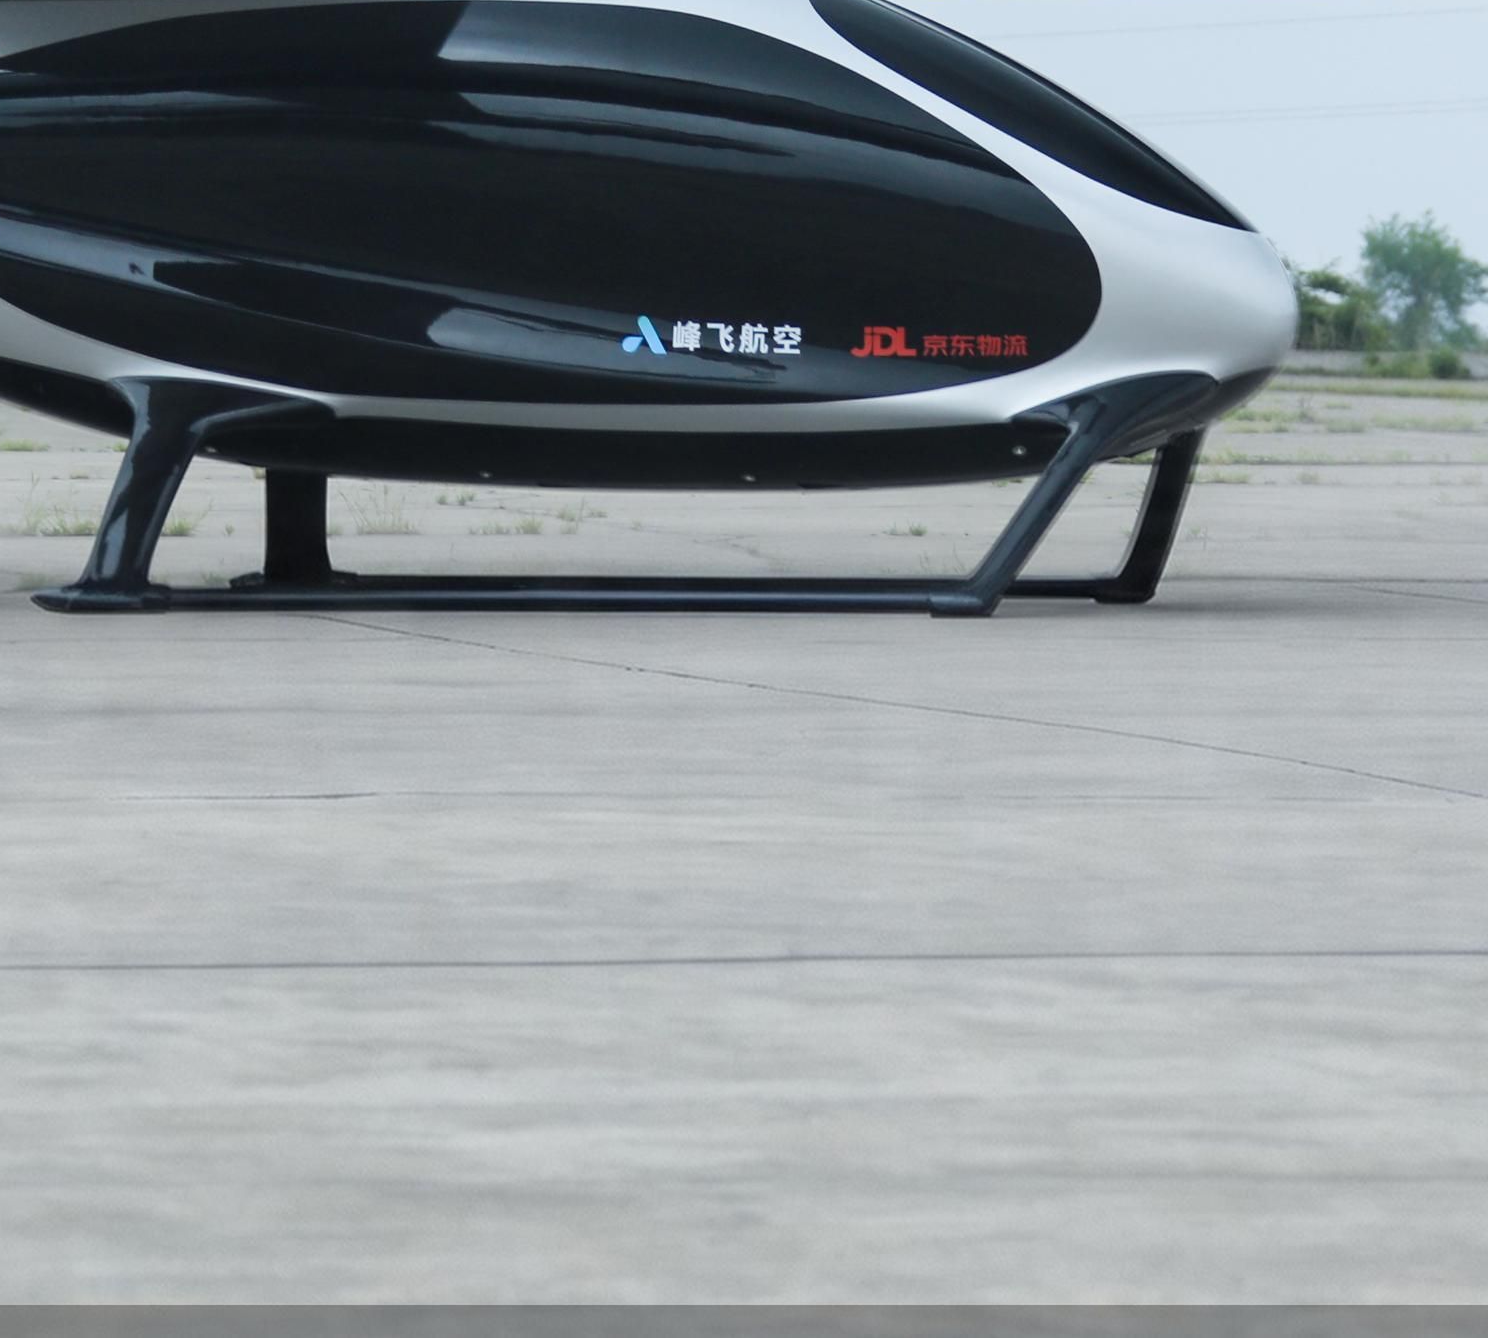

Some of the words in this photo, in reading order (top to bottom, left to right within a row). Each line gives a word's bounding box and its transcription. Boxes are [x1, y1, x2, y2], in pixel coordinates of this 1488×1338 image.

[672, 320, 802, 355] 峰飞航空
[850, 326, 916, 357] JDL
[923, 334, 1029, 357] 京东物流
